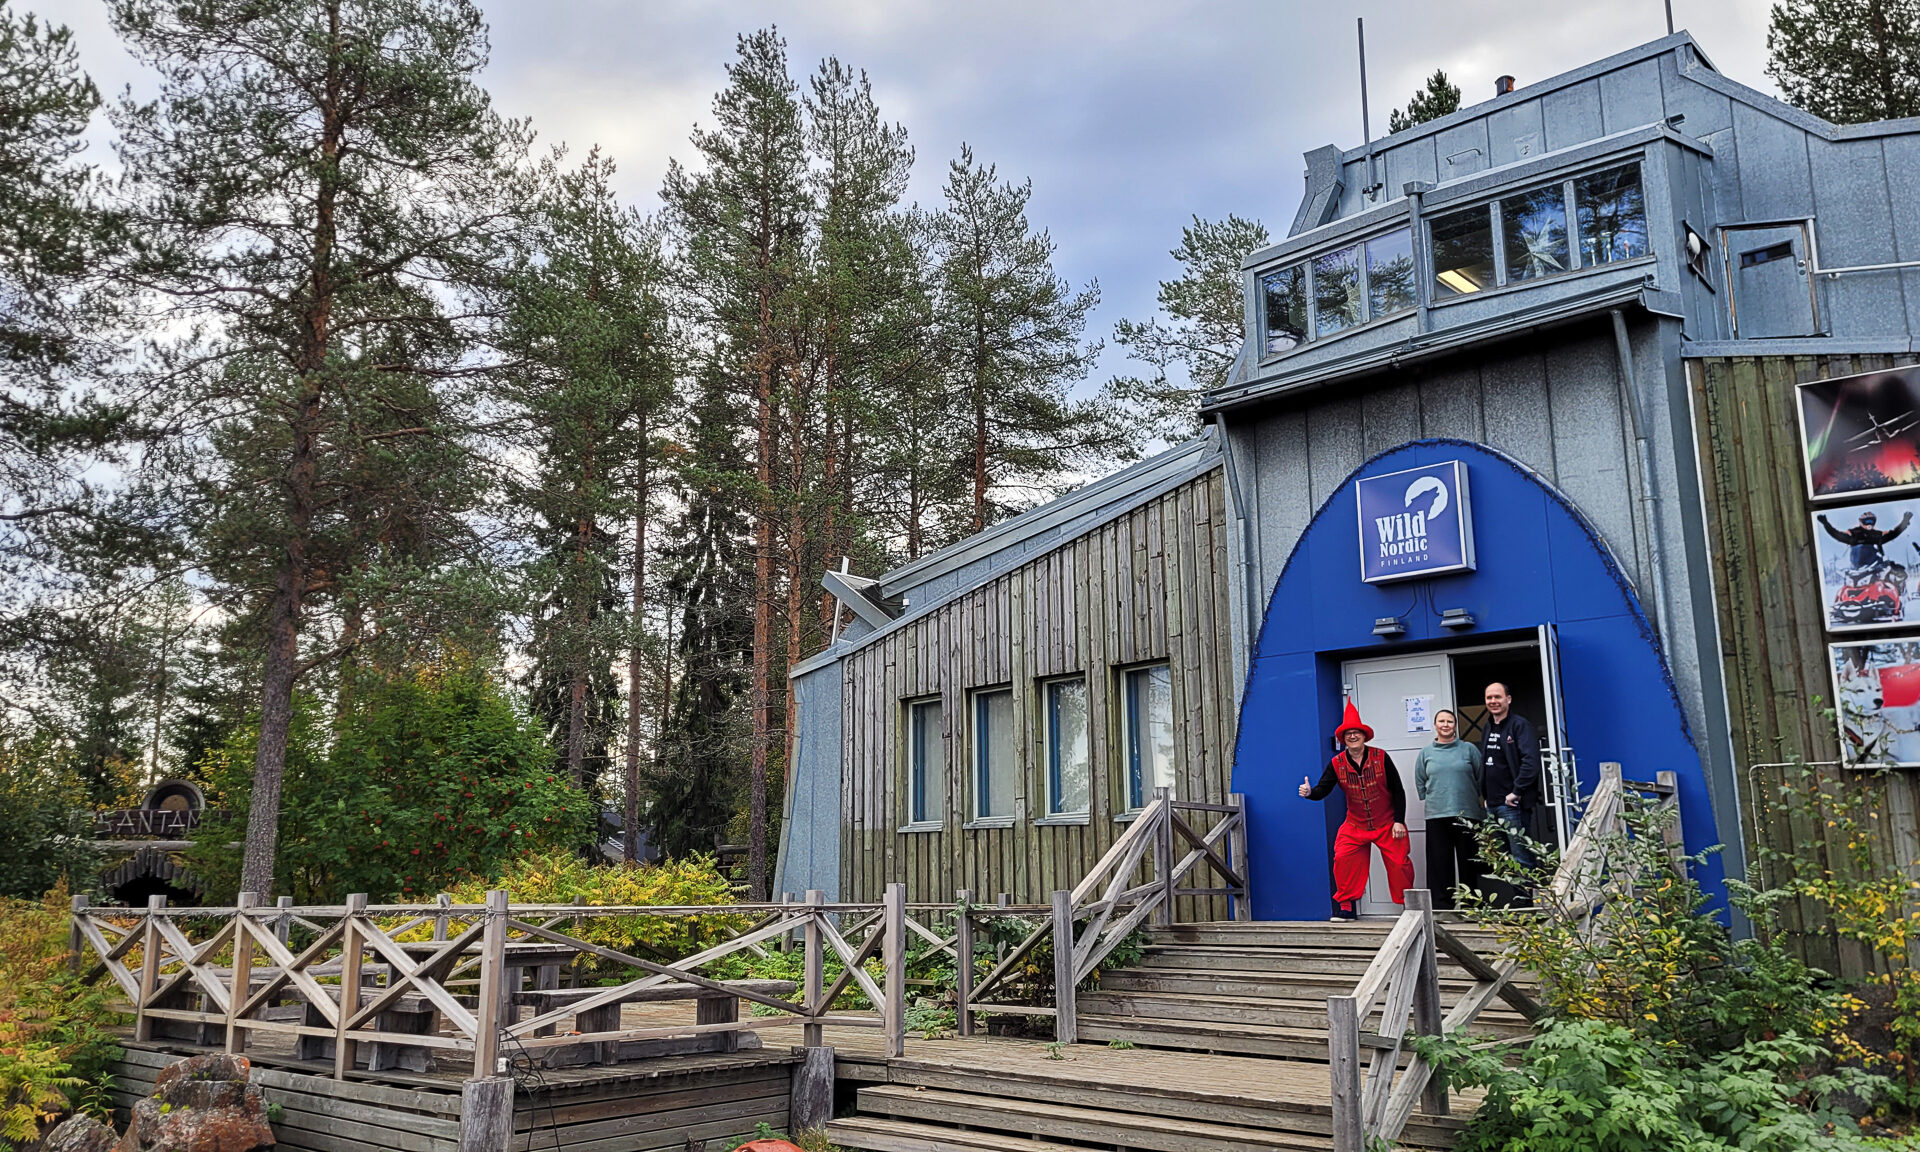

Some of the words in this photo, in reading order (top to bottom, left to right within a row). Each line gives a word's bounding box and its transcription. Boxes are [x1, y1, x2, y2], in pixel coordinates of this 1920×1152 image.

[1375, 510, 1427, 544] Wild
[1380, 537, 1428, 558] Nordic
[1380, 553, 1429, 568] FINLAND
